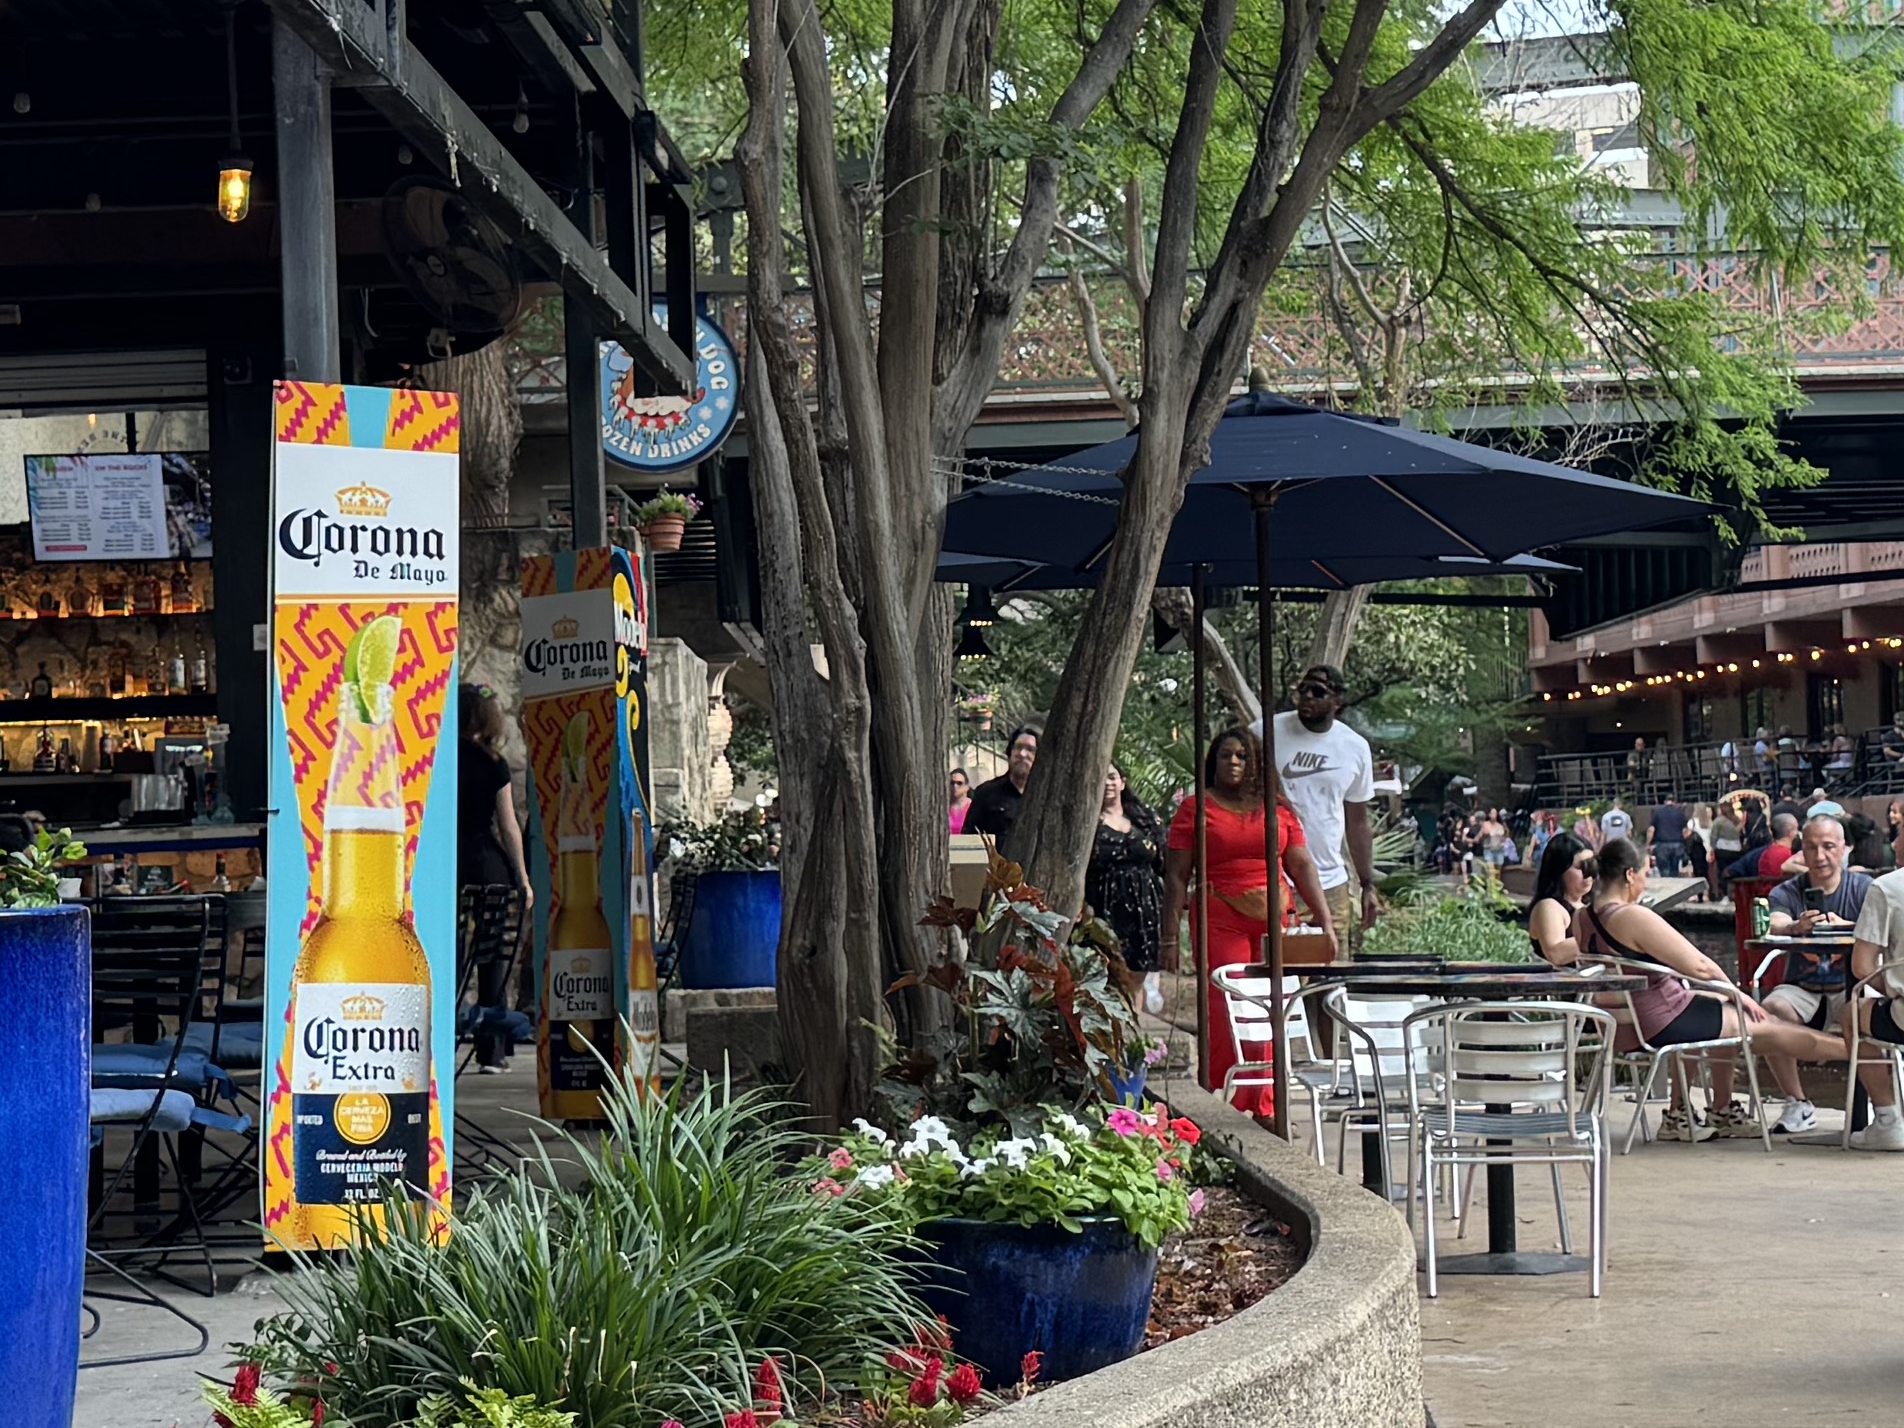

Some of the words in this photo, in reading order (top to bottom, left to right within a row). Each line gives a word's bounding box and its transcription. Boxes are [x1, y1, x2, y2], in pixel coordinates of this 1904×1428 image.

[699, 342, 730, 390] DOG
[602, 422, 643, 456] OZEN
[647, 423, 711, 459] DRINKS
[279, 508, 445, 568] Corona
[353, 559, 380, 579] De
[388, 561, 446, 586] Mayo
[524, 638, 608, 676] Corona
[562, 667, 576, 681] De
[579, 665, 609, 679] Mayo
[1292, 751, 1329, 769] NIKE
[554, 972, 609, 1000] Corona
[566, 996, 598, 1012] Extra
[303, 1015, 421, 1065] Corona
[331, 1055, 396, 1081] Extra
[339, 1106, 385, 1116] CERVEZA
[354, 1097, 369, 1106] LA
[320, 1162, 371, 1174] CERVECERIA
[372, 1162, 404, 1173] MODELO
[348, 1149, 366, 1161] and
